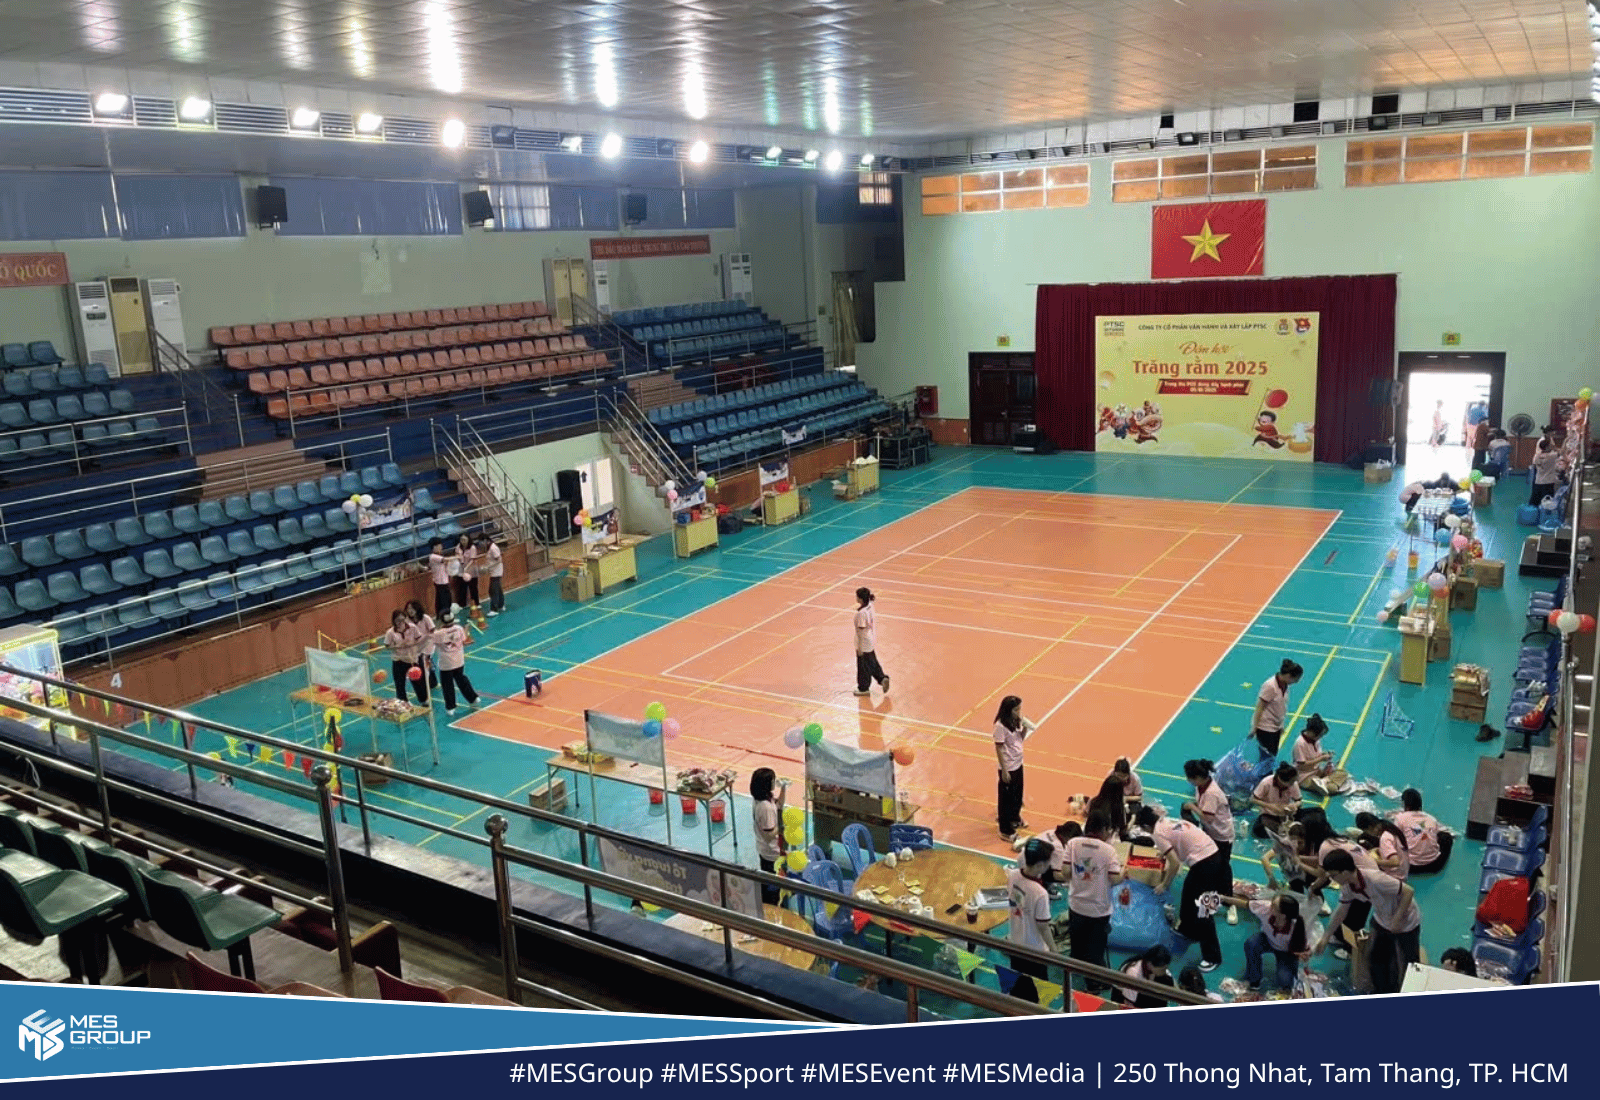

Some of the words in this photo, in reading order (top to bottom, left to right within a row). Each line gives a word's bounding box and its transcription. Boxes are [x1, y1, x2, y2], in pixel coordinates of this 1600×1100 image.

[14, 258, 58, 281] QUỐC
[1132, 359, 1180, 377] Trăng
[1186, 355, 1219, 375] rằm
[1225, 360, 1268, 375] 2025
